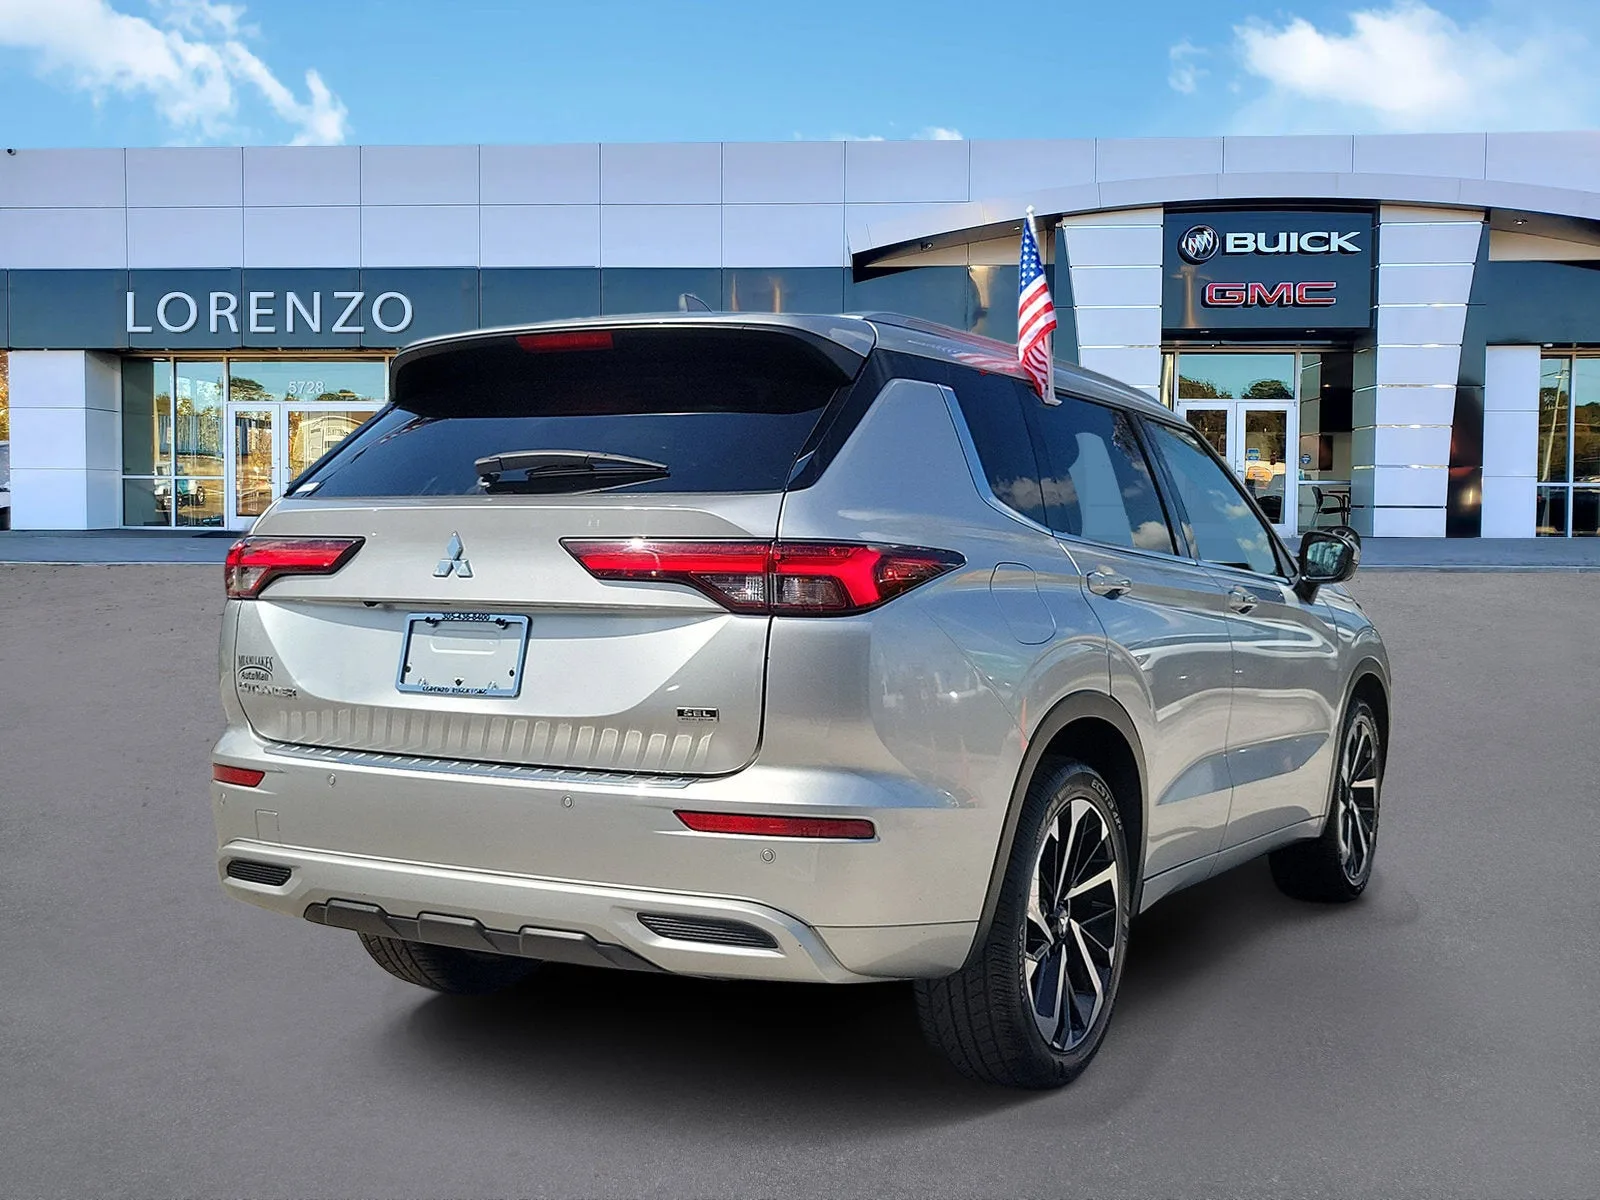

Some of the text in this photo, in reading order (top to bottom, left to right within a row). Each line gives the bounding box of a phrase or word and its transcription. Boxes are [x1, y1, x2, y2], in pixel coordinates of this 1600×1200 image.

[1225, 231, 1362, 253] BUICK
[1205, 281, 1337, 305] GMC
[126, 291, 413, 333] LORENZO
[288, 380, 325, 394] 5728
[255, 655, 273, 672] LAKES
[683, 709, 711, 717] SEL
